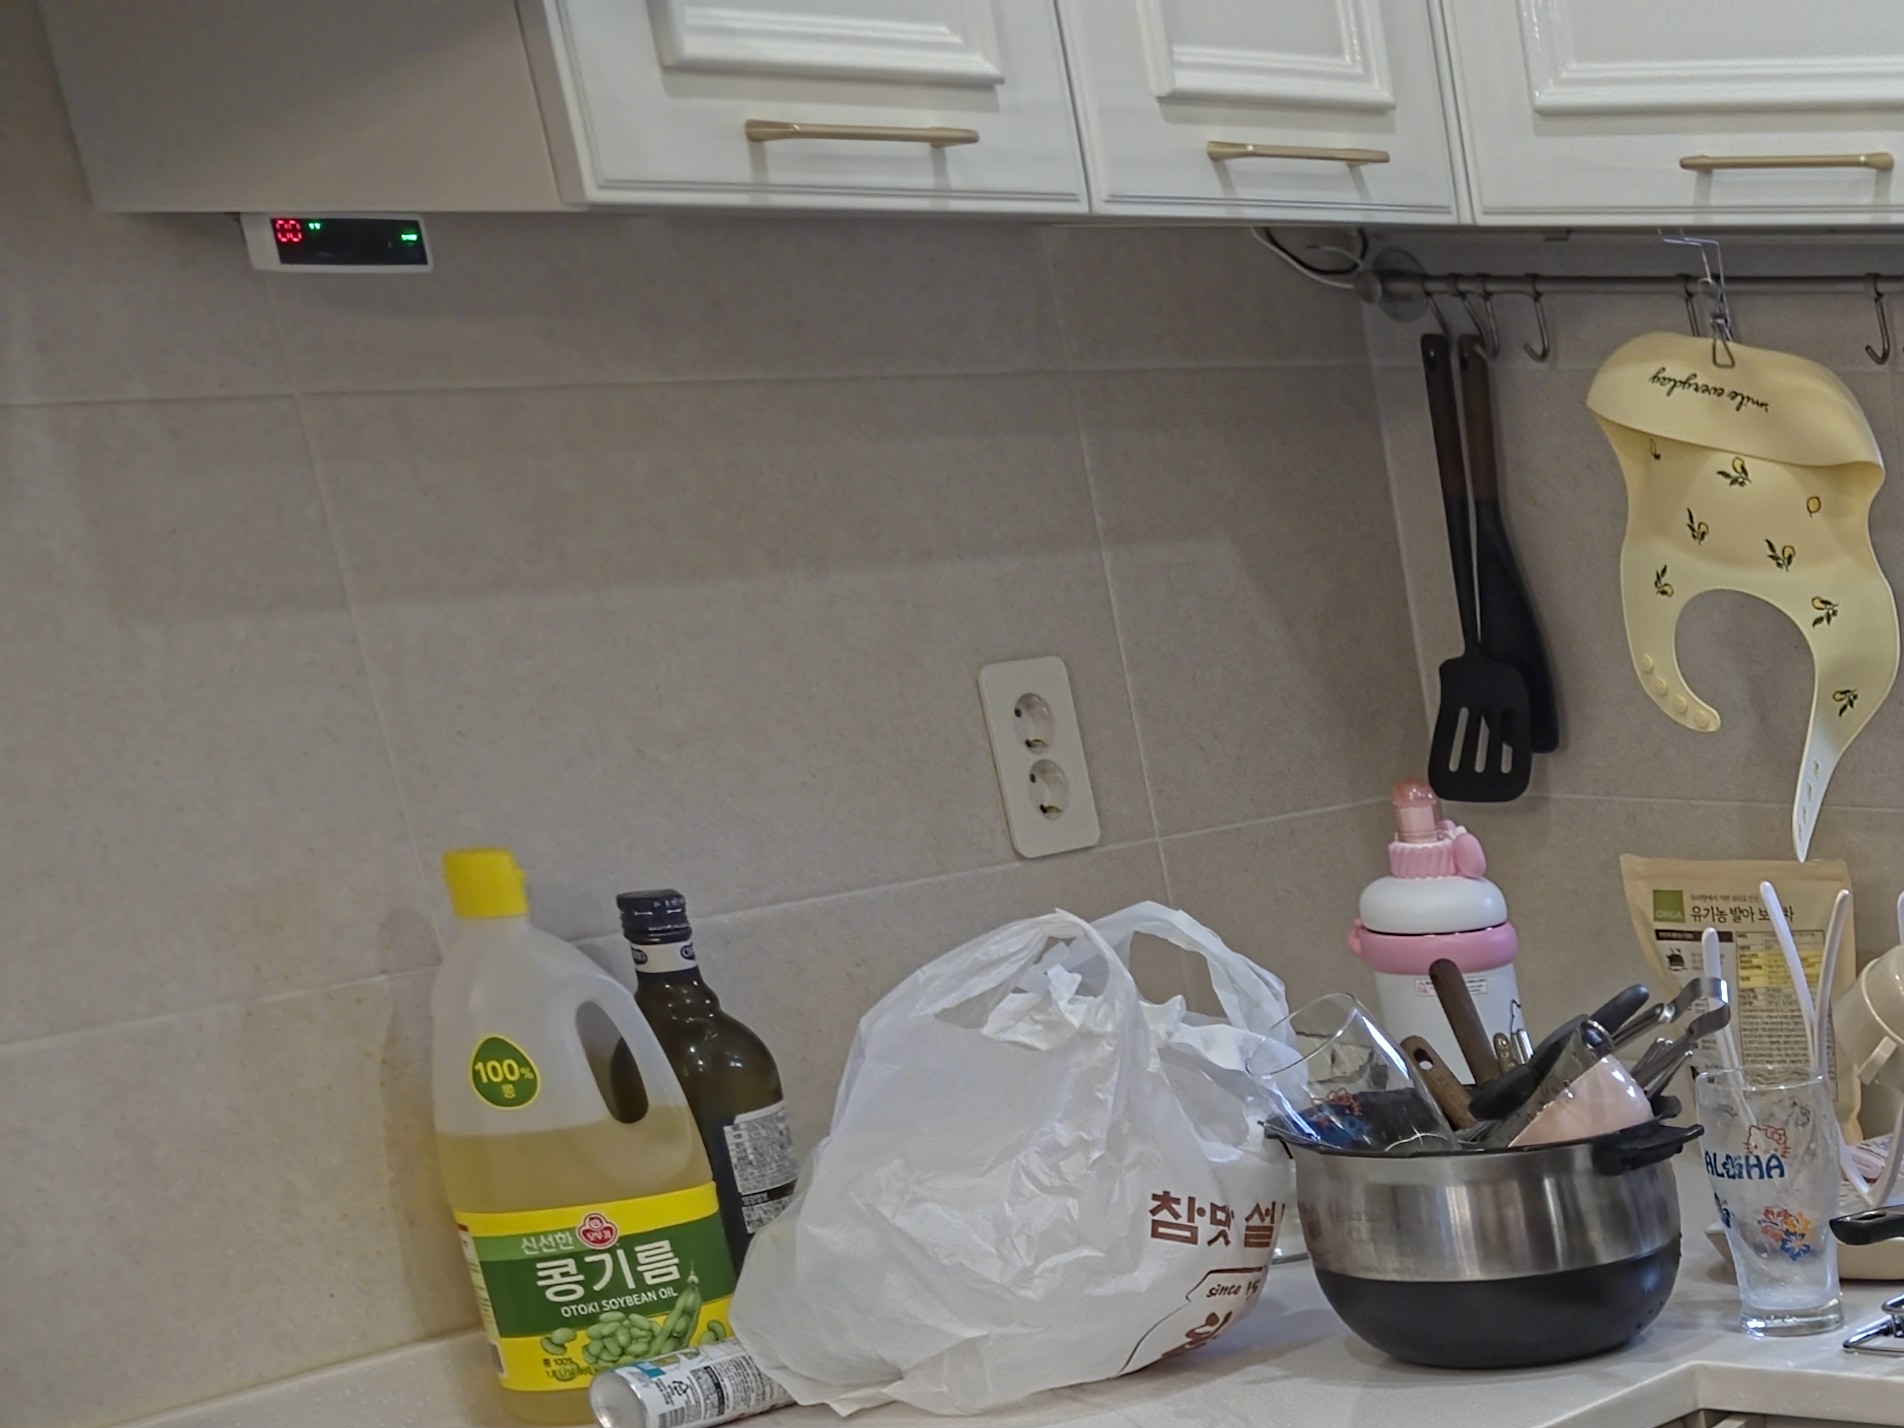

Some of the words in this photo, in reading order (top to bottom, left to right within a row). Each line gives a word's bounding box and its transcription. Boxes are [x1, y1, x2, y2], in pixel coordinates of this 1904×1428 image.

[1649, 367, 1725, 397] everyday
[1728, 390, 1769, 413] smile
[1690, 905, 1728, 923] 유기농
[1729, 906, 1755, 923] 발아
[474, 1059, 534, 1084] 100%
[1149, 1190, 1235, 1247] 참맛
[1244, 1201, 1285, 1248] 설
[521, 1231, 575, 1256] 신선한
[536, 1239, 681, 1303] 콩기름
[601, 1291, 657, 1312] SOYBEAN
[658, 1286, 678, 1299] OIL
[1206, 1283, 1241, 1298] since
